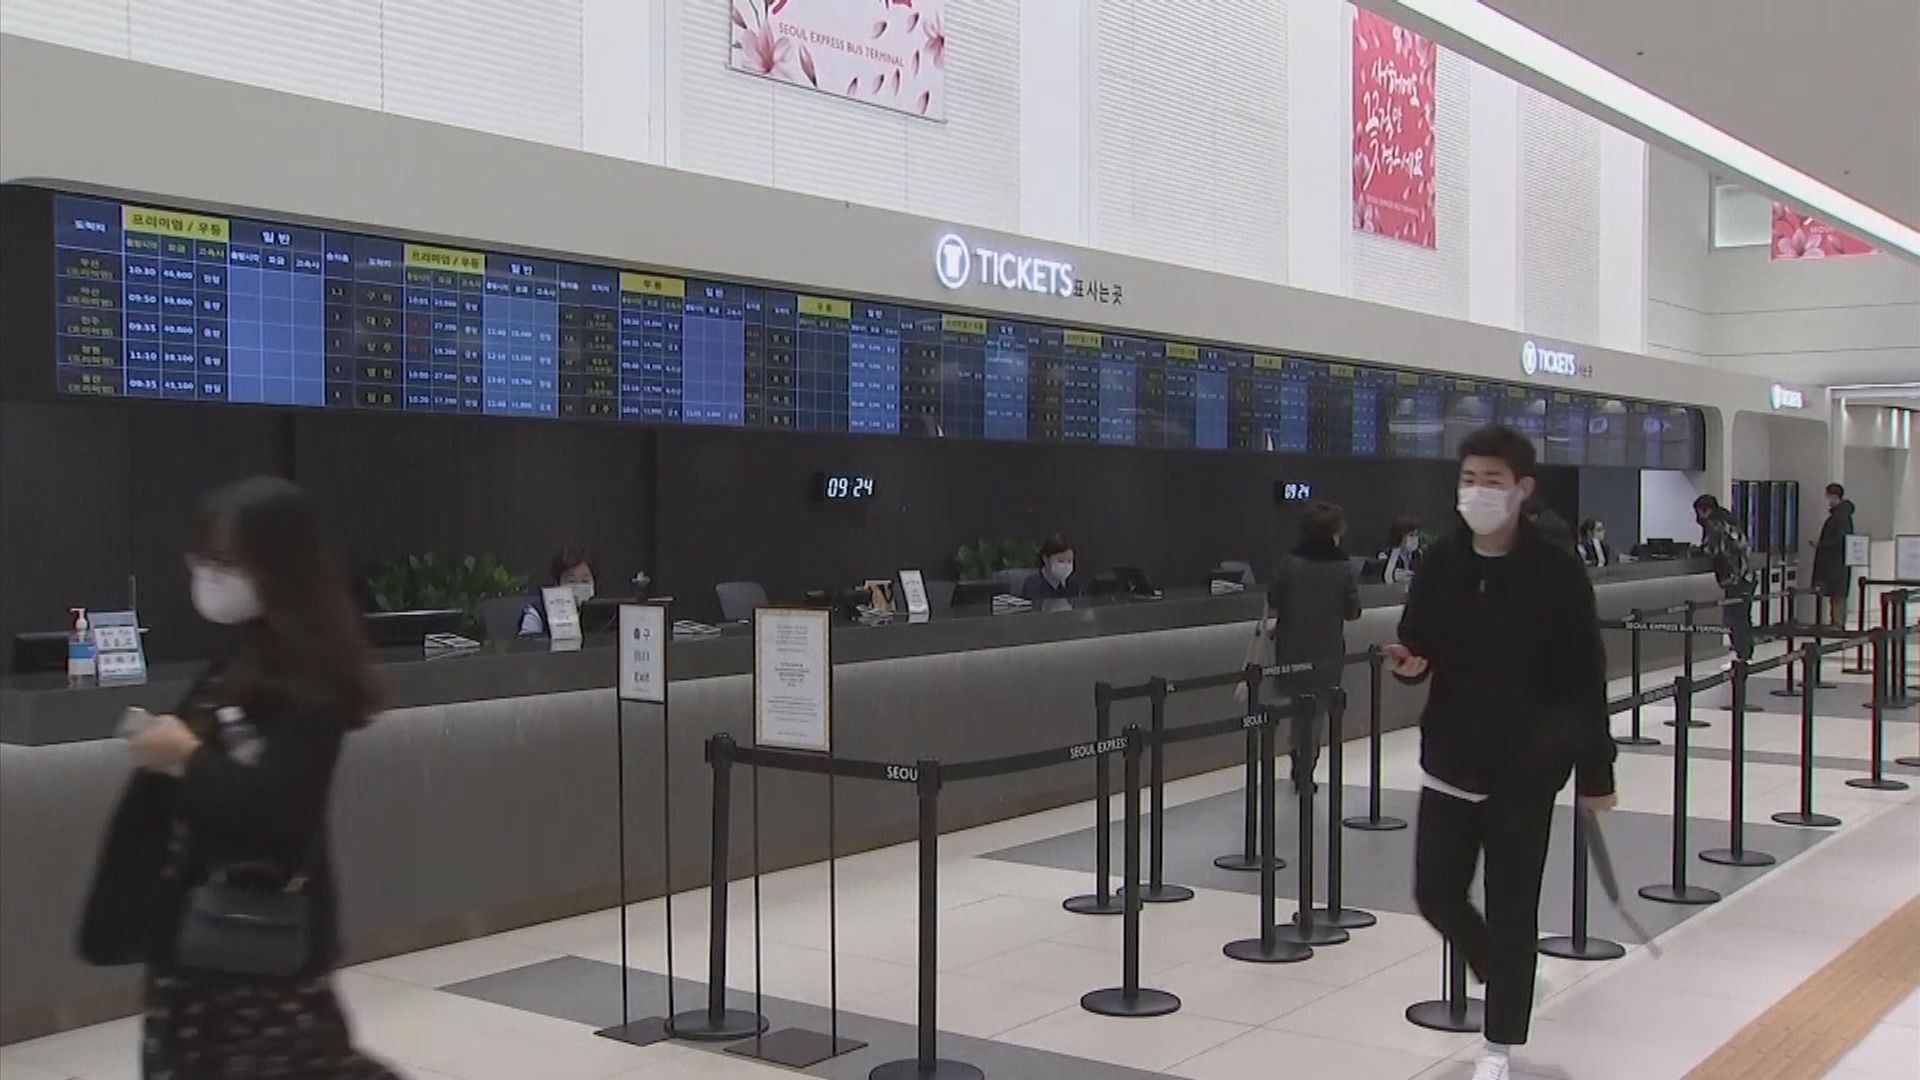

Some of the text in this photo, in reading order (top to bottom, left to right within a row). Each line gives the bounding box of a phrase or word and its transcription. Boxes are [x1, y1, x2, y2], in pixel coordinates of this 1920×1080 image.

[779, 22, 905, 67] SEOUL EXPRESS BUS TERMINAL
[132, 214, 183, 231] 프리미엄
[199, 222, 221, 236] 우등
[976, 248, 1073, 297] TICKETS
[1112, 284, 1123, 305] 곳
[1537, 348, 1576, 376] TICKETS
[634, 671, 650, 684] Exit
[1069, 737, 1129, 760] SEOUL EXPRES
[887, 765, 919, 782] SEOU
